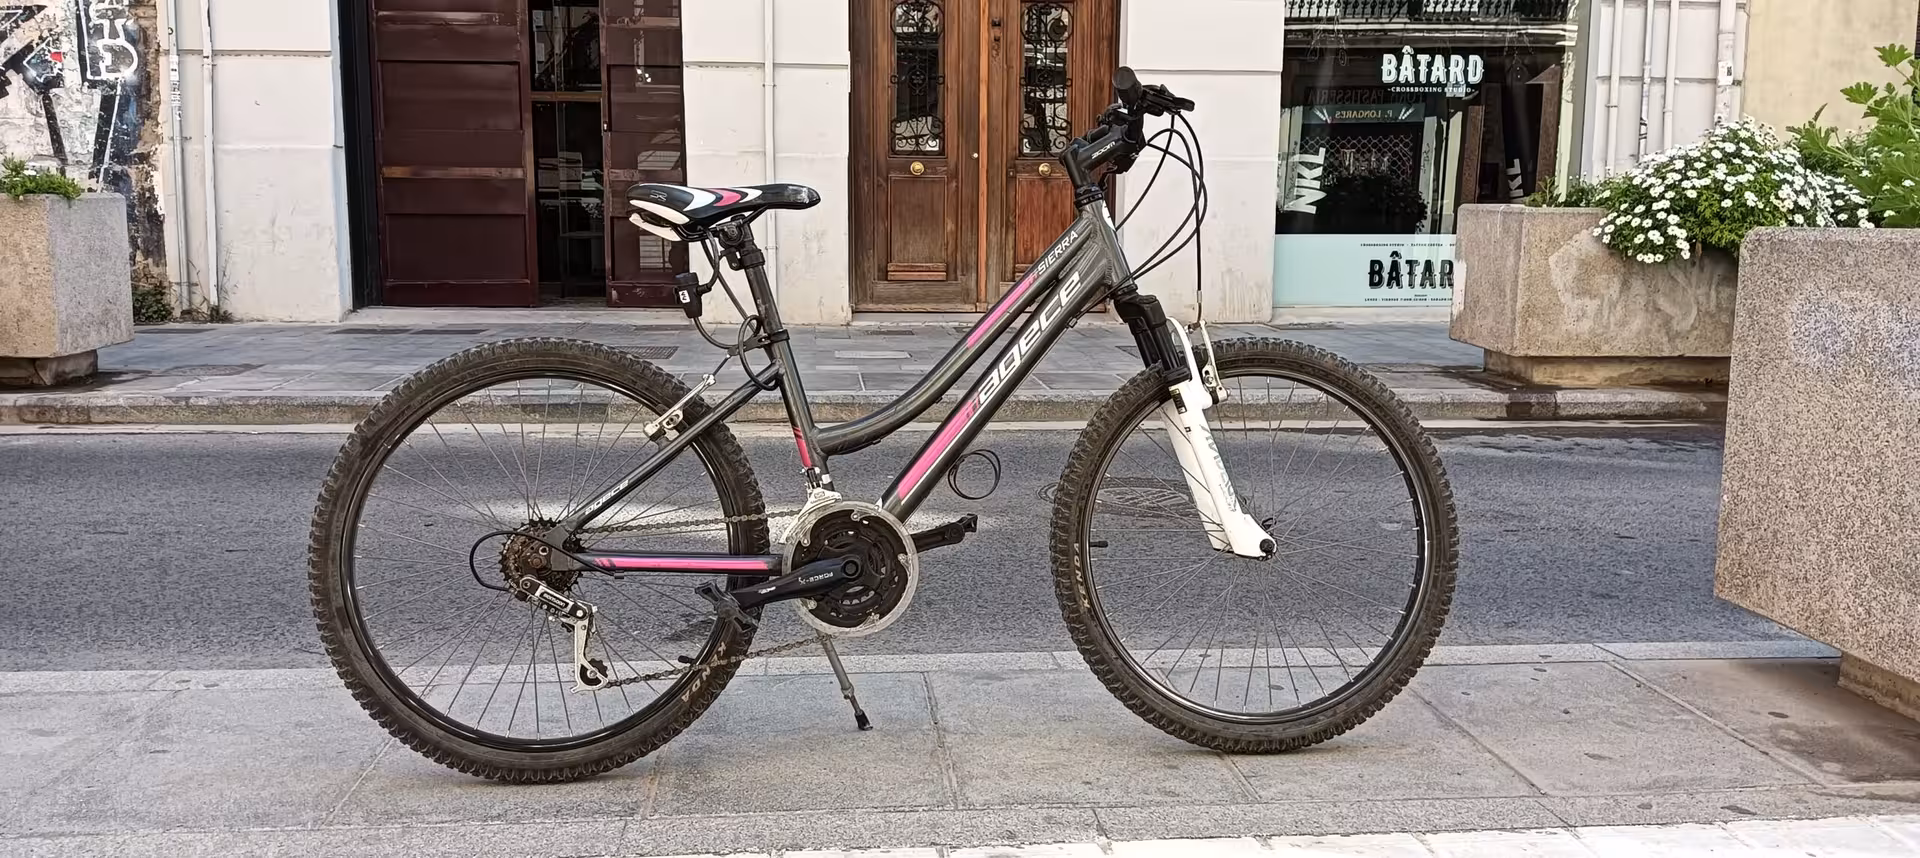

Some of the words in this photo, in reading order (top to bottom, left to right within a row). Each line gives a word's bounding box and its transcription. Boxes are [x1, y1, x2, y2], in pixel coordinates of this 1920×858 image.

[1381, 45, 1485, 85] BÂTARD
[1505, 158, 1524, 203] KL
[1037, 230, 1079, 275] SIERRA
[1368, 250, 1455, 289] BÂTAR
[977, 270, 1082, 405] agece
[1073, 542, 1091, 609] KENDA
